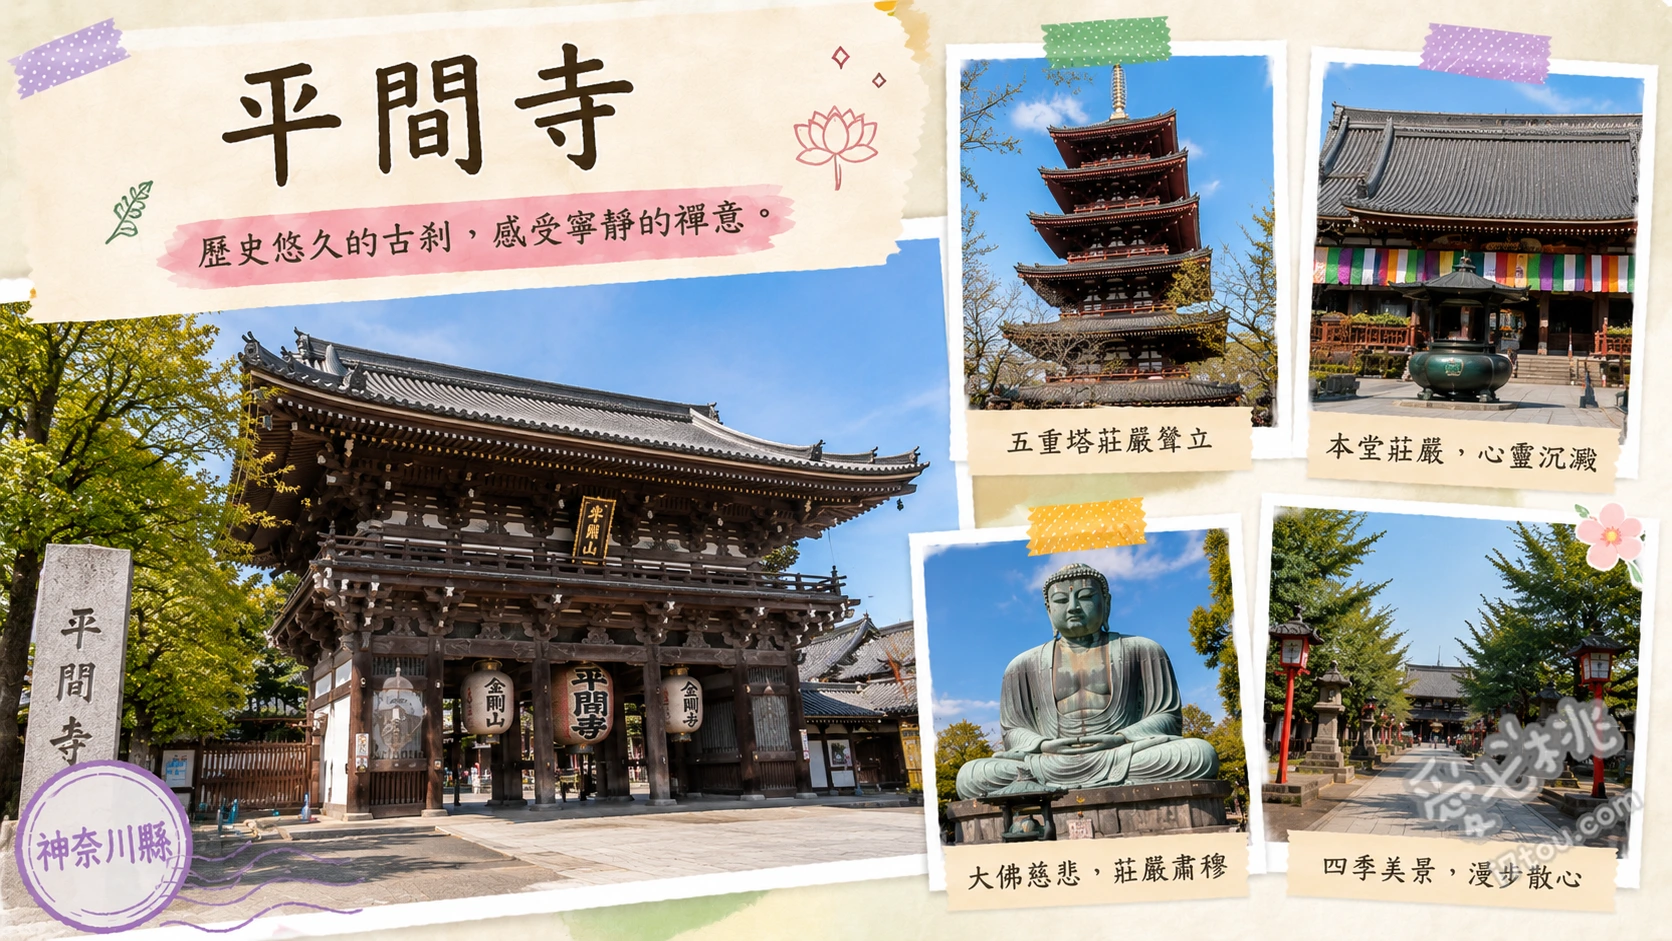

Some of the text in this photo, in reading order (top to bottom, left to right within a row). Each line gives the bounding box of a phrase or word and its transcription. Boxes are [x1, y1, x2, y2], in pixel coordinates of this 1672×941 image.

[49, 607, 101, 767] 平間寺
[484, 677, 506, 728] 金剛山
[571, 667, 609, 740] 平間寺
